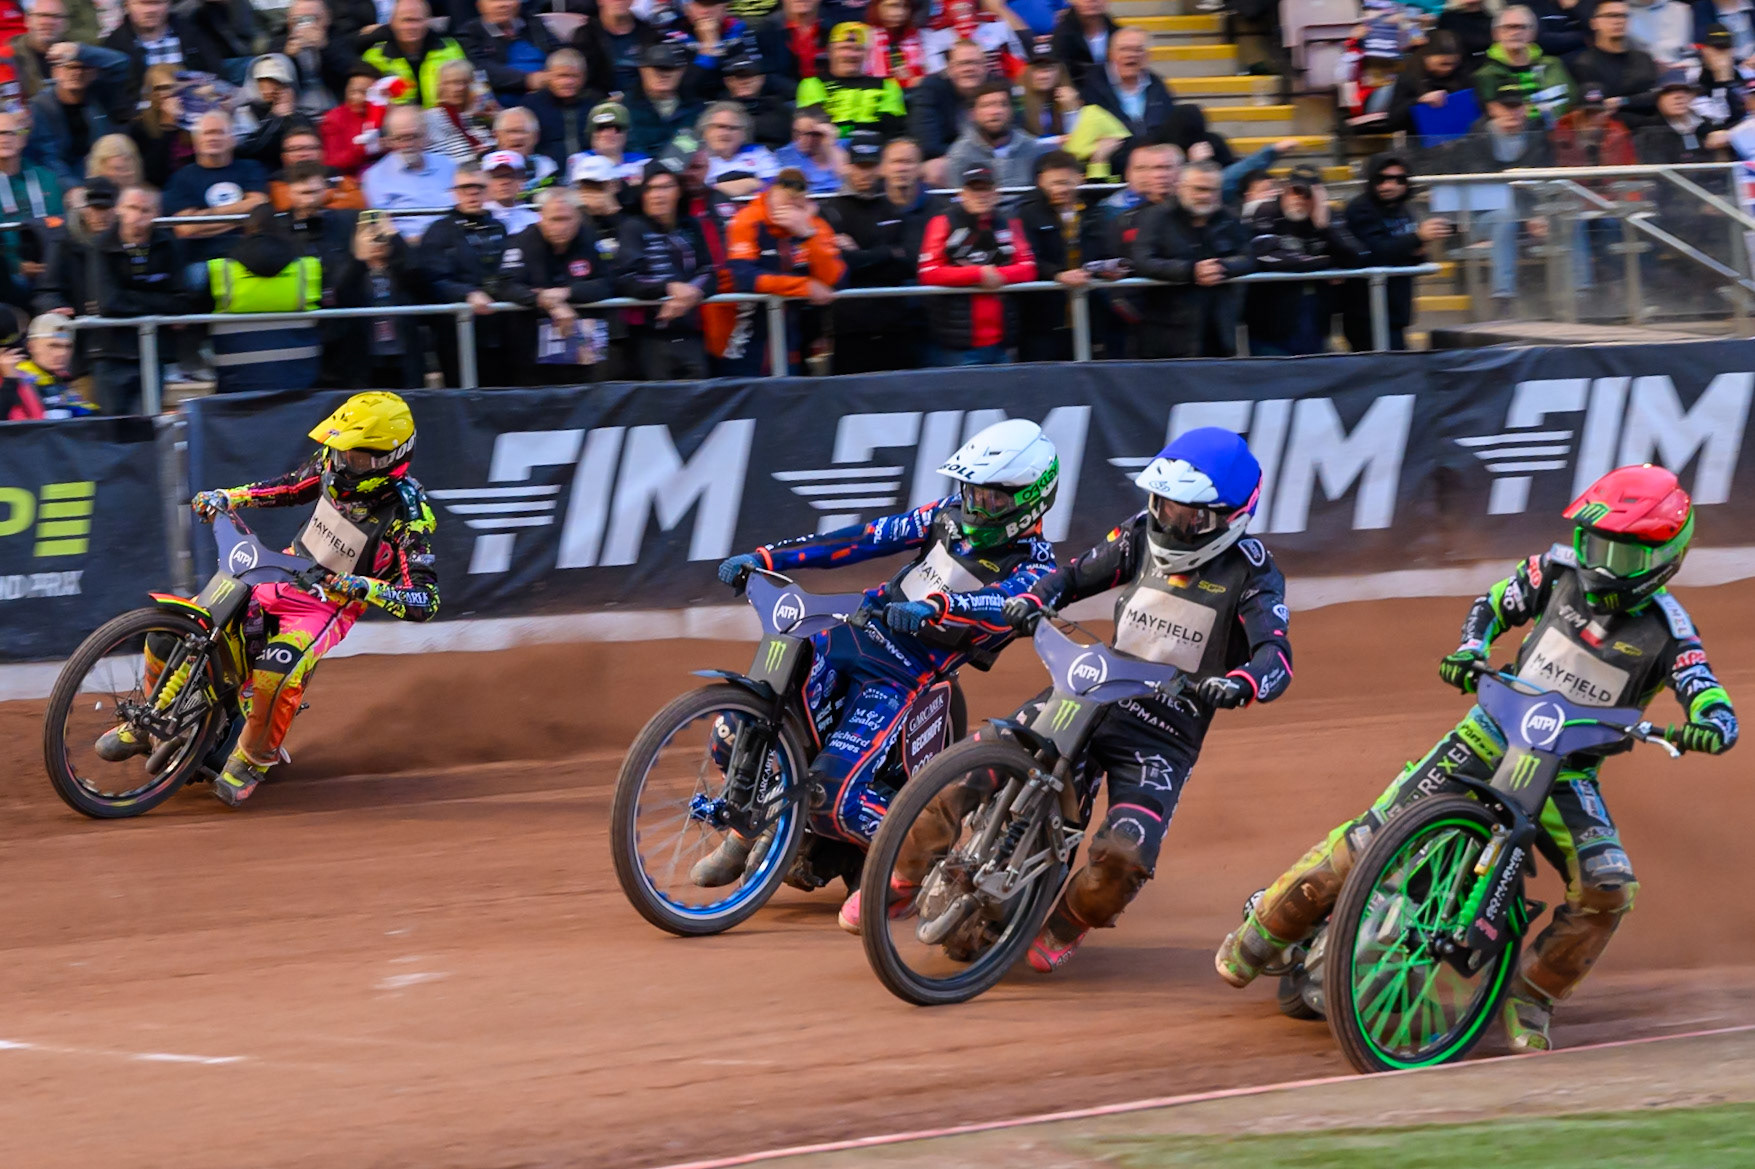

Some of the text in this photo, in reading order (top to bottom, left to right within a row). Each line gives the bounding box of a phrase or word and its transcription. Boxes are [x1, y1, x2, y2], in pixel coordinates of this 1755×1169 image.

[1454, 371, 1755, 515] FIM
[428, 418, 757, 574] FIM
[1022, 467, 1058, 501] OAKLEY
[311, 516, 357, 559] MAYFIELD
[1126, 609, 1204, 644] MAYFIELD
[1533, 653, 1612, 703] MAYFIELD
